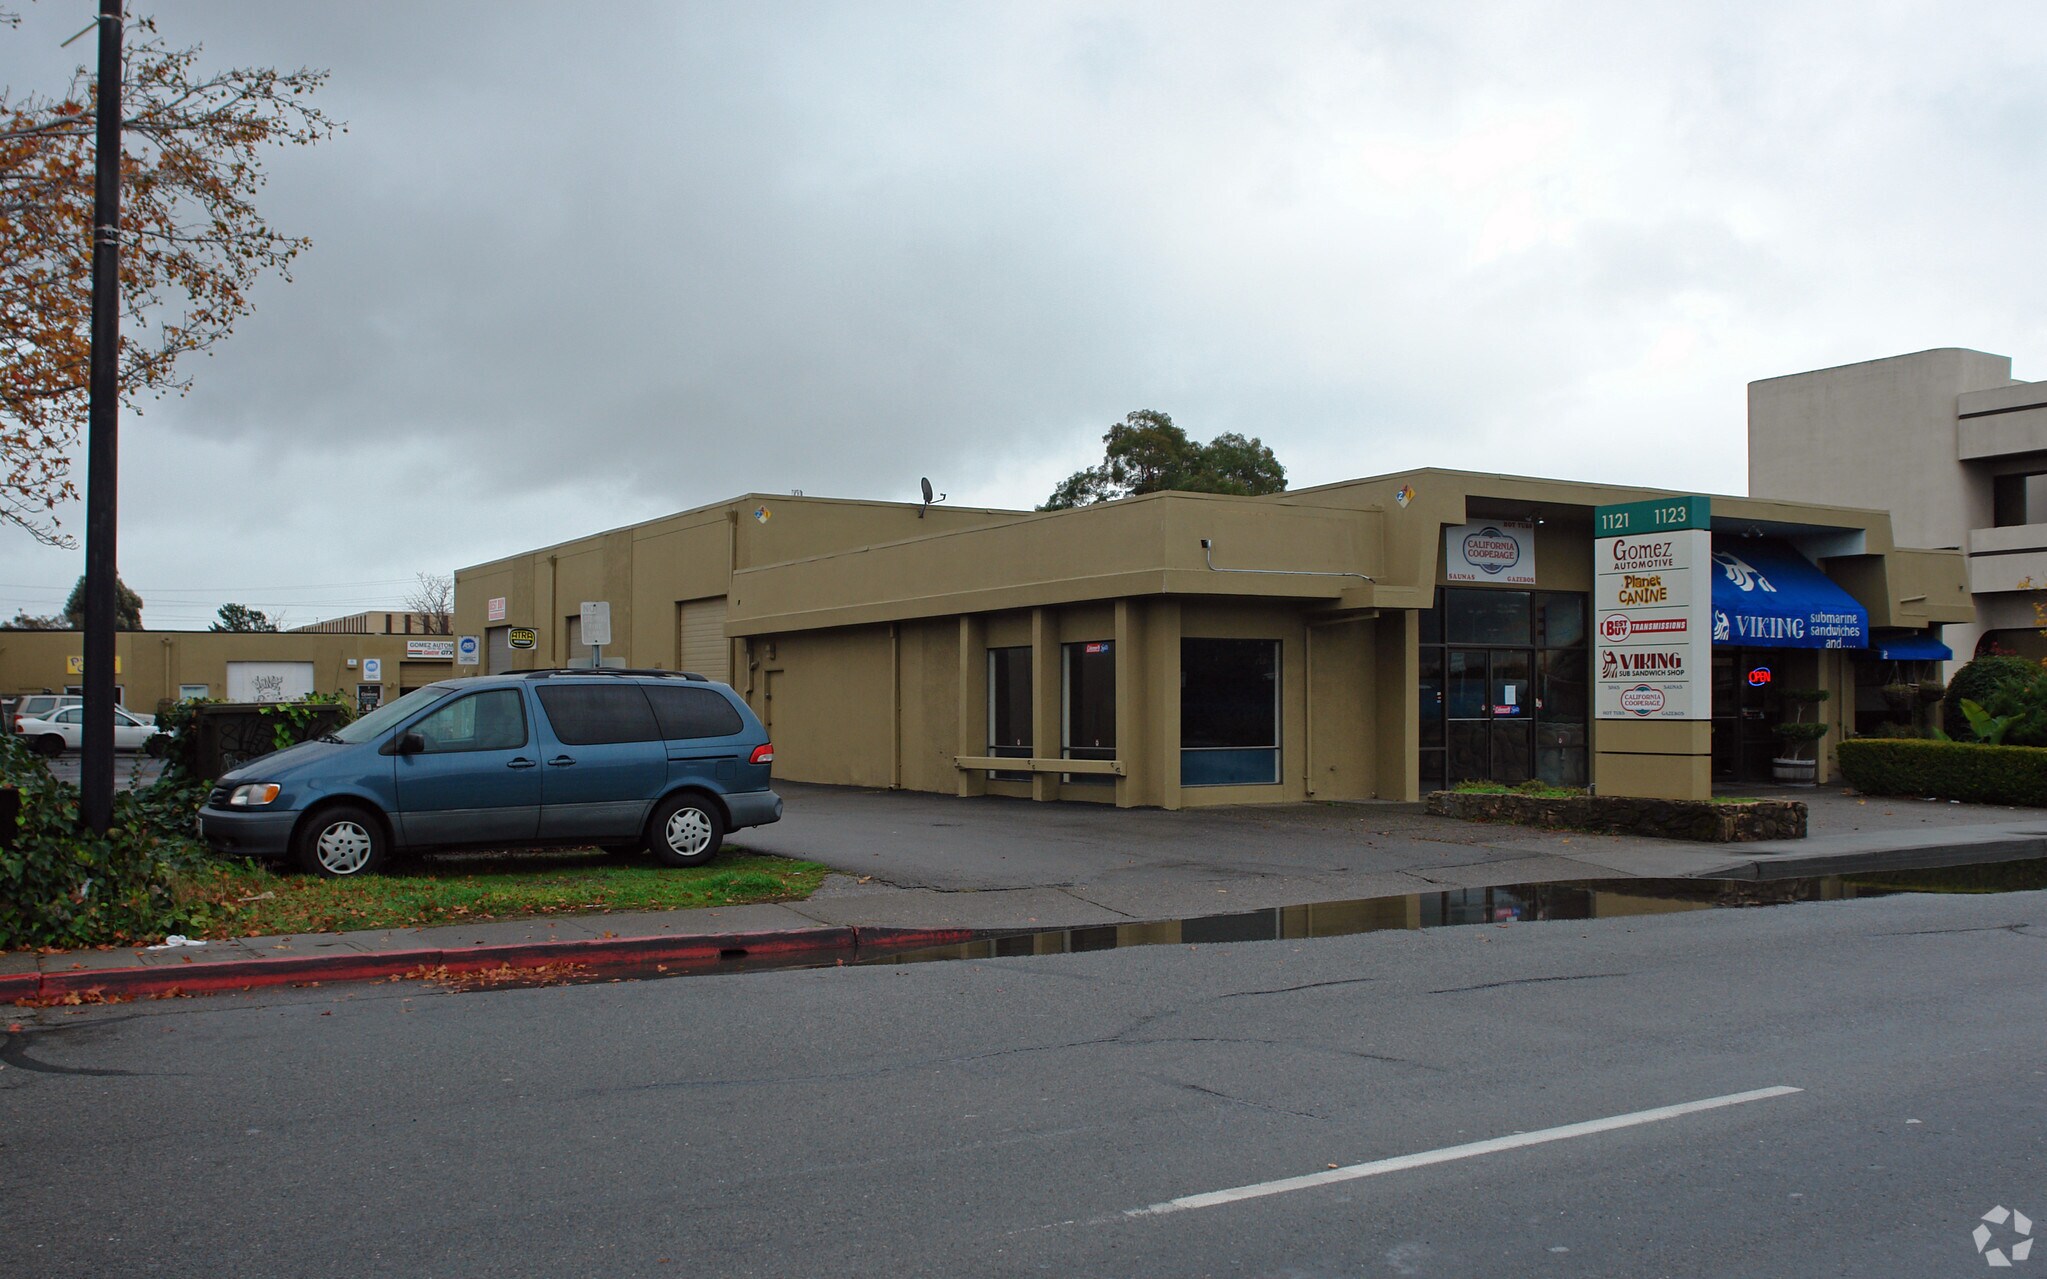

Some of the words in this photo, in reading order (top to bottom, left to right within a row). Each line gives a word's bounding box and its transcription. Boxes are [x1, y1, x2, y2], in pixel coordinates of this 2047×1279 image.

[1602, 513, 1629, 529] 1121
[1655, 507, 1686, 524] 1123
[1468, 540, 1514, 550] CALIFORNIA
[1614, 540, 1672, 561] Gomez
[1468, 549, 1514, 559] COOPERAGE
[1614, 559, 1673, 570] AUTOMOTIVE
[1624, 575, 1662, 588] Planet
[1619, 587, 1667, 605] CANINE
[1810, 612, 1858, 624] submarine
[1632, 622, 1686, 631] TRANSMISSIONS
[1736, 616, 1804, 639] VIKING
[1810, 624, 1860, 637] sandwiches
[512, 632, 532, 640] ATRA
[1620, 652, 1682, 670] VIKING
[1749, 671, 1771, 682] OPEN
